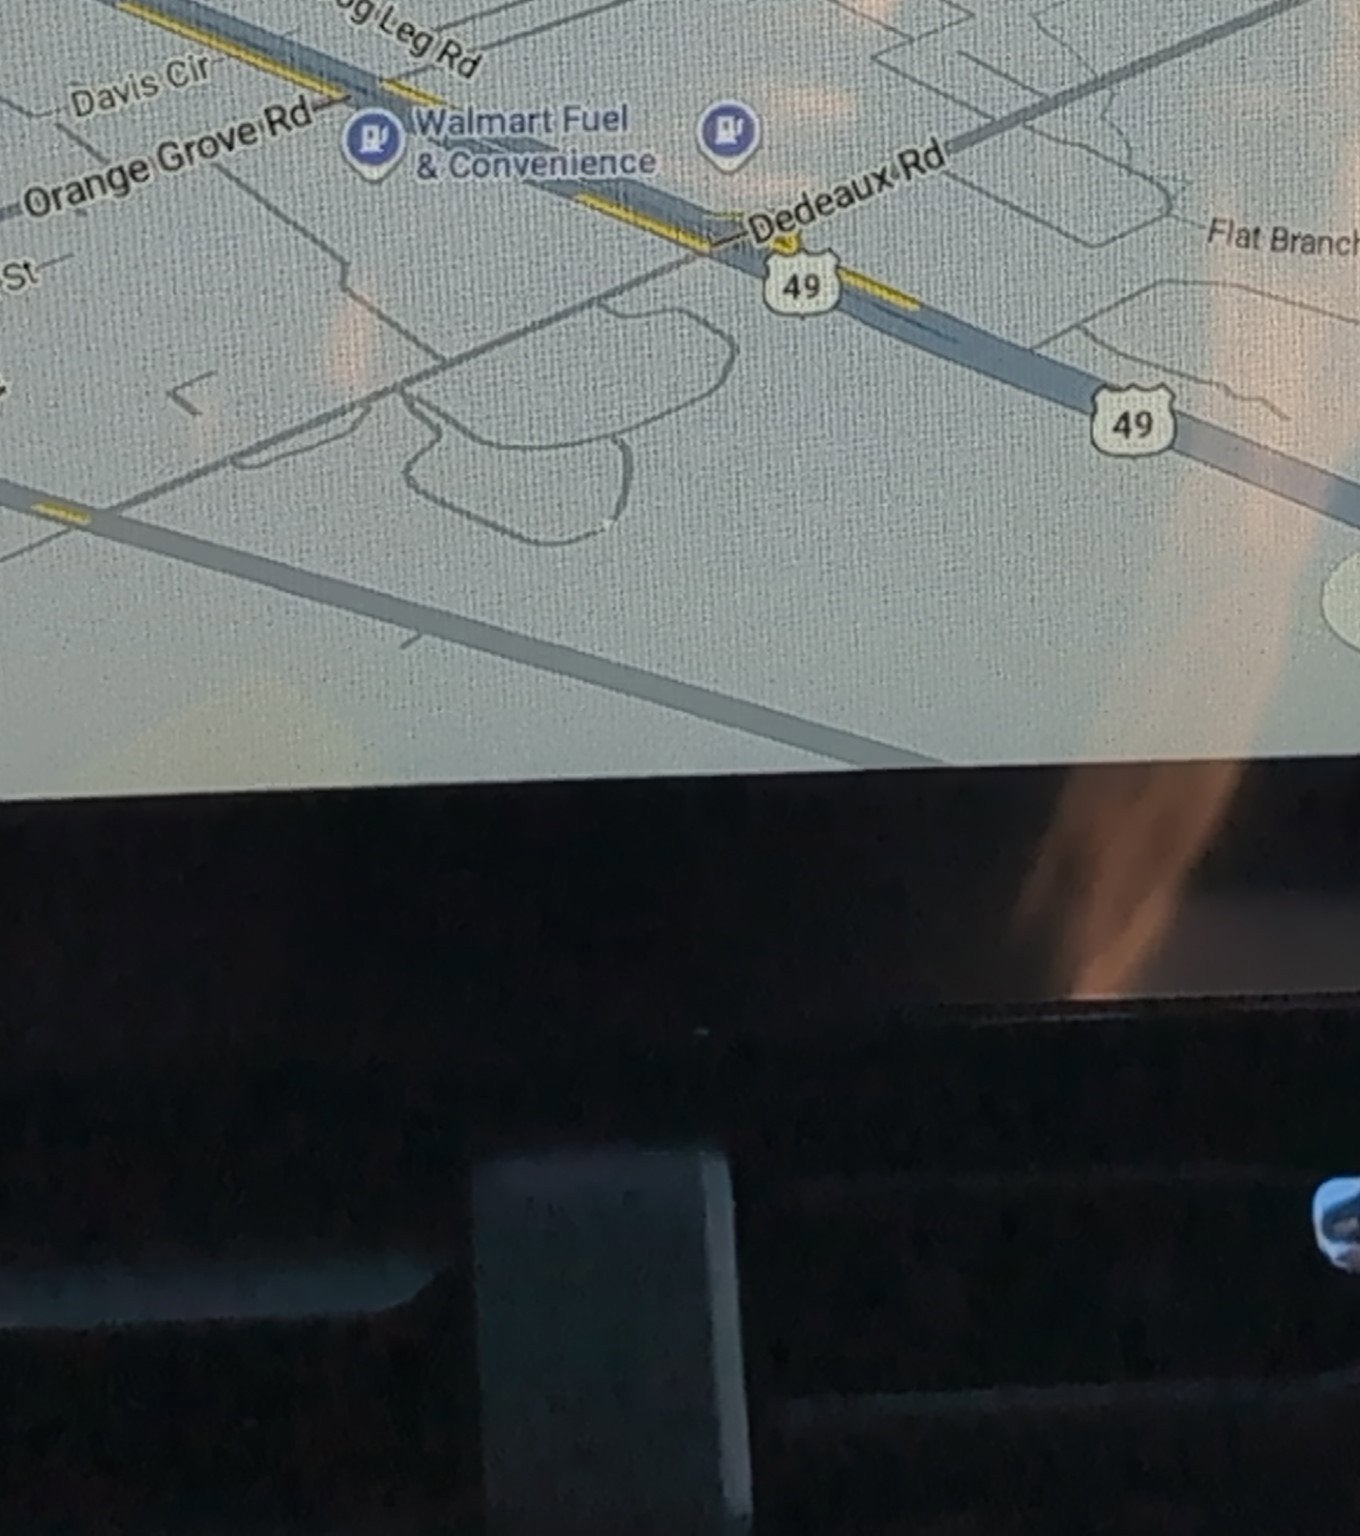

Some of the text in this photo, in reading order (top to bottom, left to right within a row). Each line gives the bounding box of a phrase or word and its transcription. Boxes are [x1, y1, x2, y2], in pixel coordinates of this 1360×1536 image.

[379, 4, 436, 60] Leg
[436, 39, 483, 80] Rd
[70, 54, 209, 119] Davis Cir
[412, 106, 628, 139] Walmart Fuel
[22, 94, 314, 218] Orange Grove Rd
[416, 151, 658, 181] & Convenience
[747, 137, 948, 246] Dedeaux Rd
[1207, 217, 1264, 251] Flat
[1, 260, 38, 292] St
[782, 272, 822, 300] 49
[1112, 410, 1154, 439] 49
